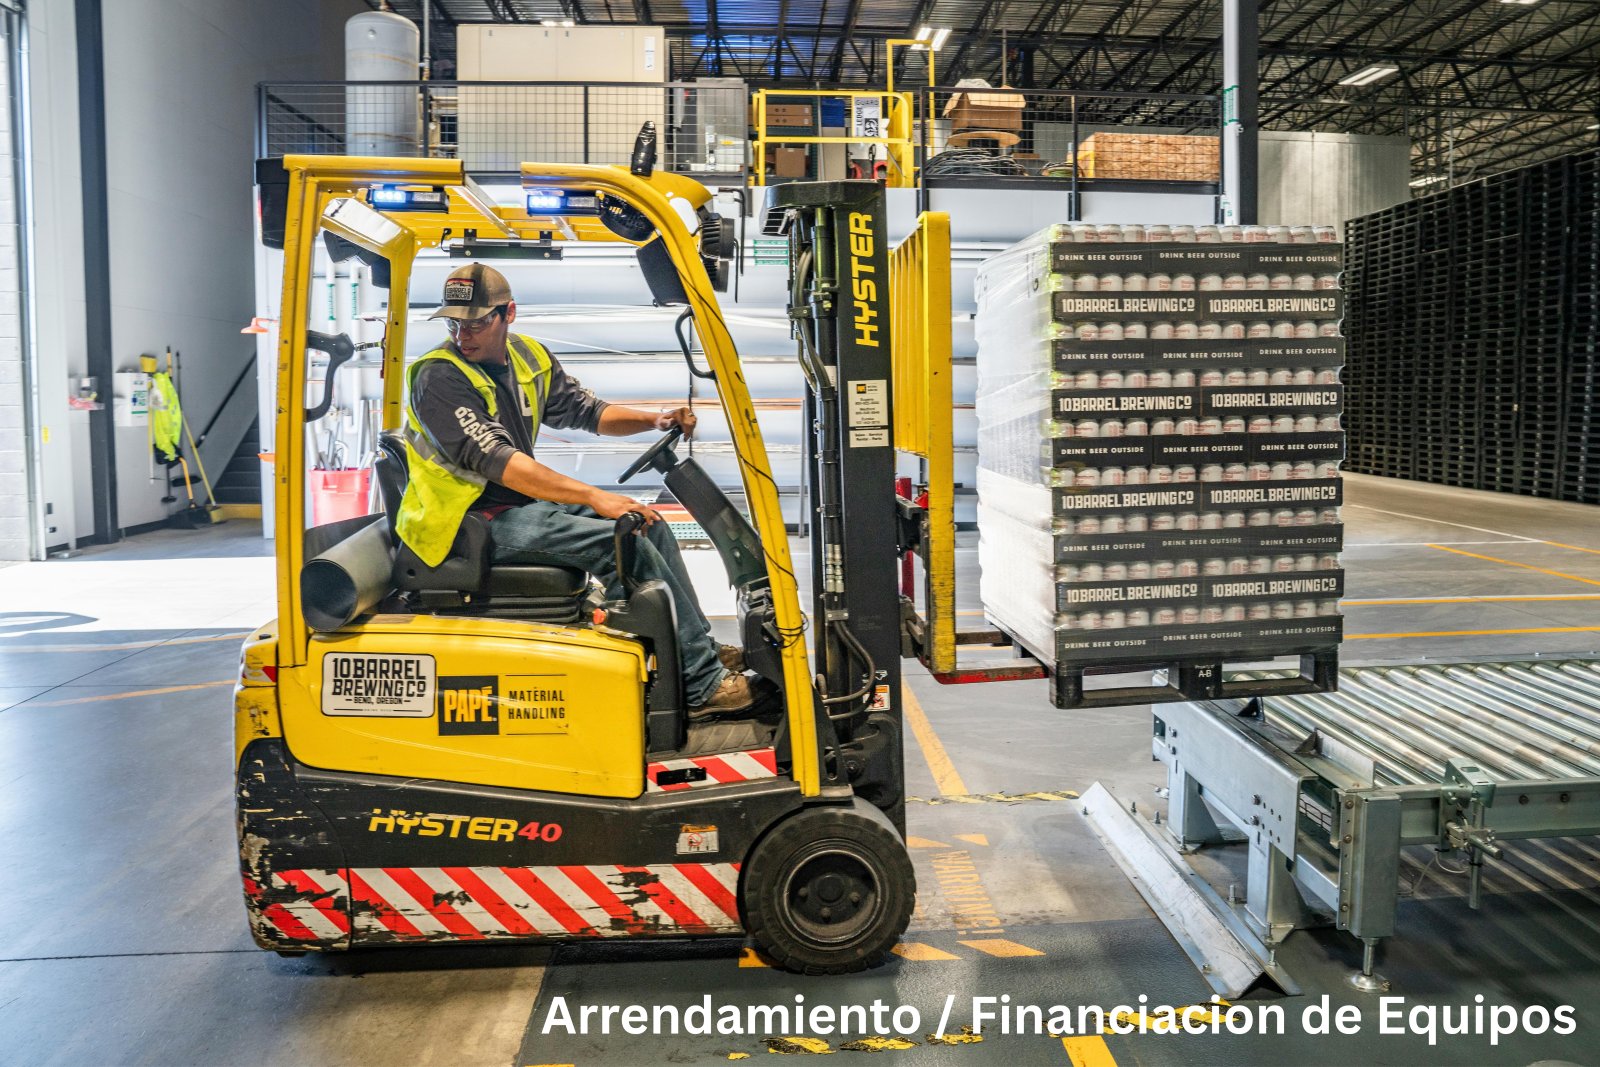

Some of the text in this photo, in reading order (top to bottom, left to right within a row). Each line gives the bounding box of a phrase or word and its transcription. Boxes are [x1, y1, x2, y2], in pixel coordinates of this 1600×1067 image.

[1109, 253, 1143, 261] OUTSIDE
[849, 212, 879, 347] HYSTER
[1110, 446, 1144, 454] OUTSIDE
[1287, 443, 1305, 451] BEER
[1209, 537, 1242, 545] OUTSIDE
[1306, 536, 1337, 544] OUTSIDE
[1112, 542, 1146, 550] OUTSIDE
[1210, 631, 1243, 639] OUTSIDE
[1259, 628, 1283, 636] DRINK
[1305, 626, 1337, 634] OUTSIDE
[1092, 640, 1112, 648] BEER
[1113, 639, 1147, 647] OUTSIDE
[508, 707, 565, 719] HANDLING
